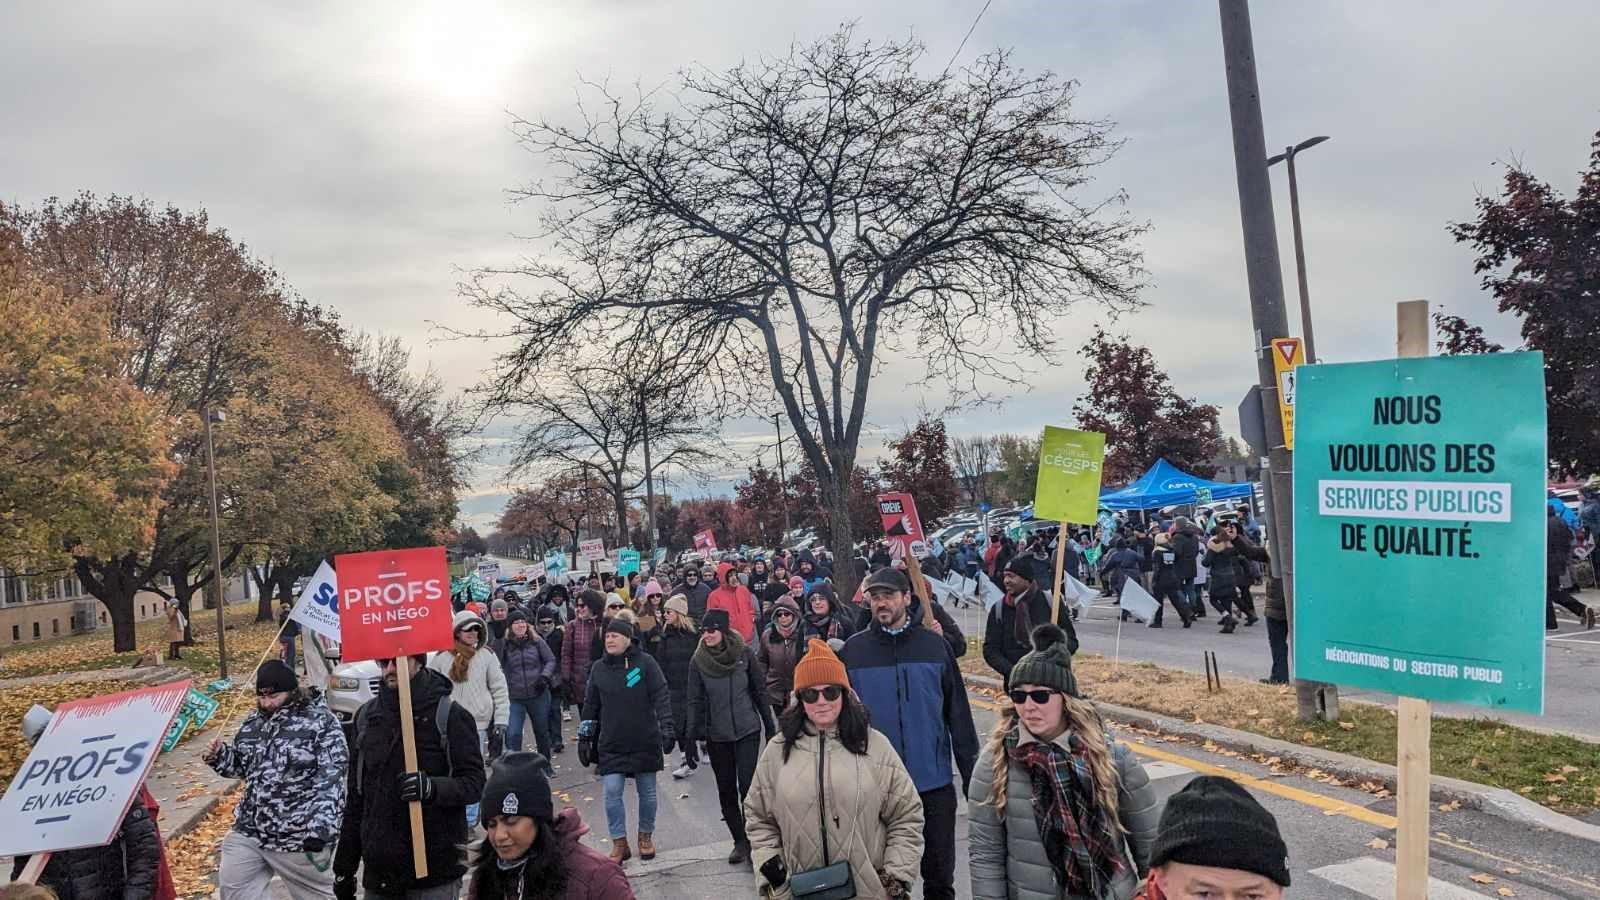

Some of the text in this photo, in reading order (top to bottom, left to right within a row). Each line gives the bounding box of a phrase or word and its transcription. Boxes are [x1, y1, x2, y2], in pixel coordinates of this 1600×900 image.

[1373, 395, 1442, 425] NOUS
[1328, 443, 1496, 474] VOULONS DES
[1324, 486, 1504, 515] SERVICES PUBLICS
[1340, 521, 1481, 559] DE QUALITÉ.
[344, 578, 443, 610] PROFS
[362, 606, 430, 625] EN NÉGO
[1325, 646, 1503, 684] NÉGOCIATIONS DU SECTEUR PUBLIC
[17, 740, 150, 790] PROFS
[21, 783, 107, 812] EN NÉGO
